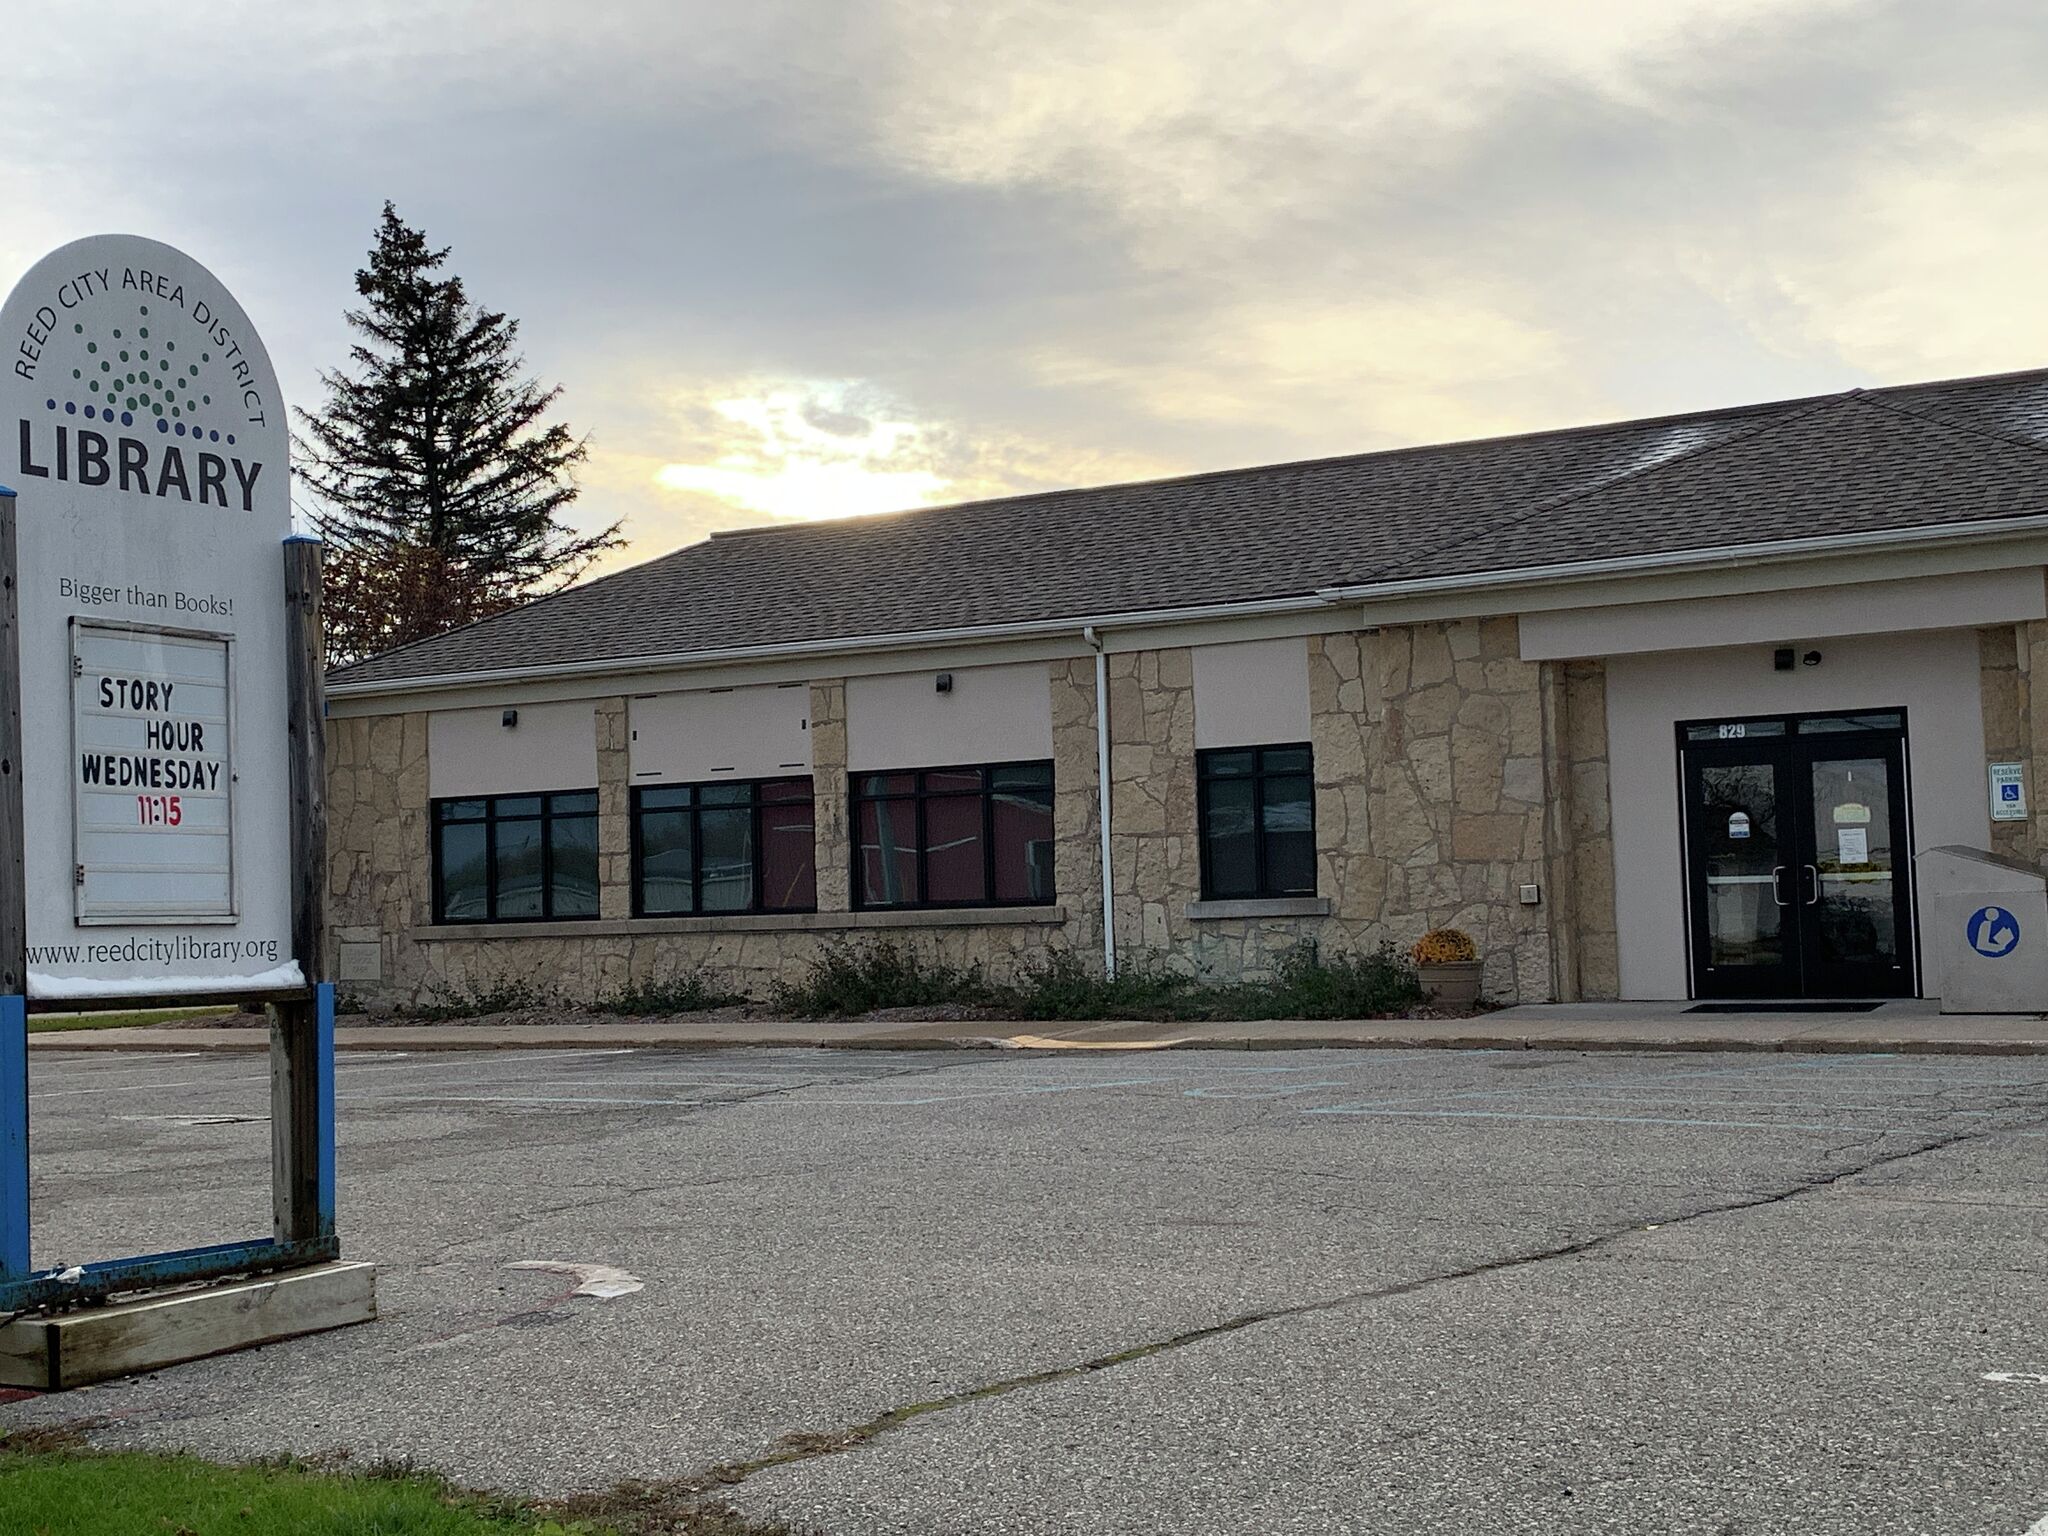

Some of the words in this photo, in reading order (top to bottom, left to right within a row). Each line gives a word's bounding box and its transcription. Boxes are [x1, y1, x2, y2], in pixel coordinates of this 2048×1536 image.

[15, 306, 57, 380] REED
[58, 268, 109, 309] CITY
[122, 267, 184, 309] AREA
[192, 301, 265, 428] DISTRICT
[19, 418, 263, 512] LIBRARY
[59, 577, 121, 605] Bigger
[127, 585, 168, 609] than
[175, 592, 233, 616] Books!
[100, 677, 173, 712] STORY
[147, 720, 204, 752] HOUR
[1719, 723, 1746, 738] 829
[82, 753, 220, 790] WEDNESDAY
[137, 796, 182, 826] 11:15
[26, 935, 278, 966] www.reedcitylibrary.org
